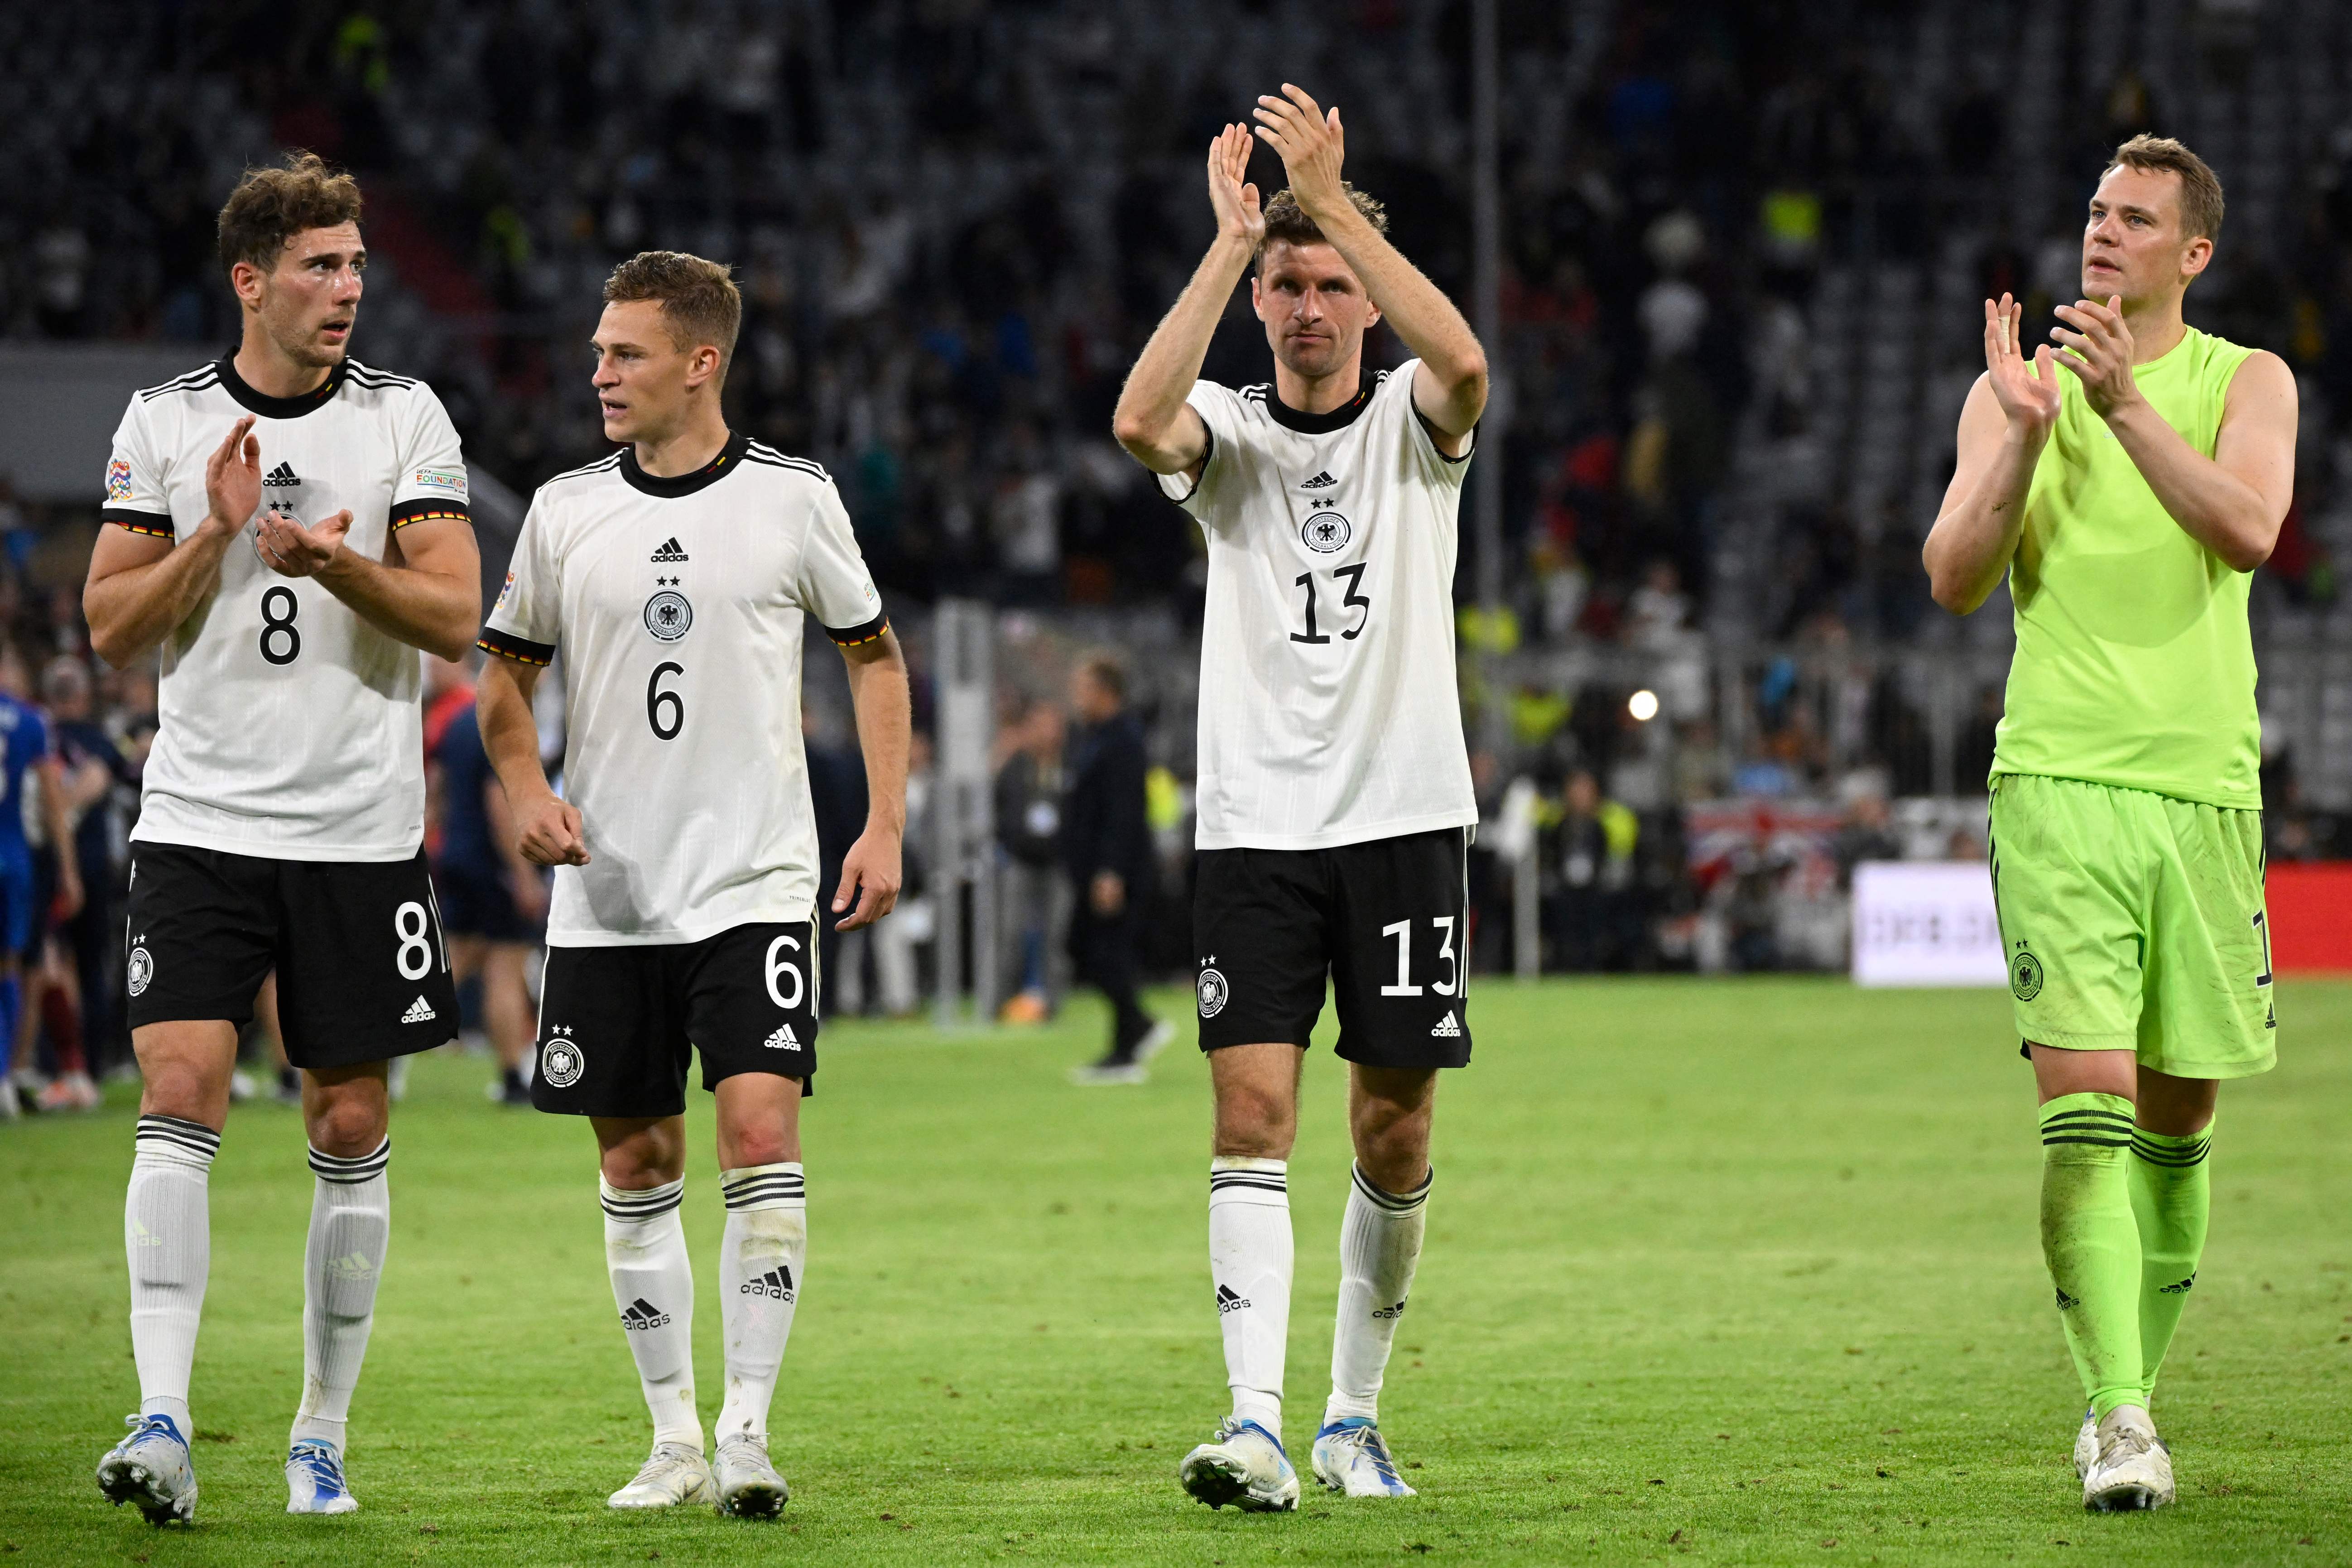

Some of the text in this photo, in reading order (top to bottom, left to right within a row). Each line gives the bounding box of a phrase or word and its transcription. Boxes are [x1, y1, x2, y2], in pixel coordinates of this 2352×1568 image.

[263, 477, 301, 487] adidas
[416, 475, 467, 488] FOUNDATION
[1301, 479, 1338, 488] adidas
[1312, 517, 1339, 526] DEUTSCHER
[650, 553, 689, 563] adidas
[655, 597, 683, 607] DEUTSCHER
[1289, 562, 1370, 645] 13
[259, 586, 301, 665] 8
[647, 661, 684, 741] 6
[394, 901, 433, 981] 8
[2252, 909, 2272, 987] 1
[1380, 915, 1456, 996] 13
[2016, 958, 2034, 970] DEUTSCHER
[765, 935, 804, 1010] 6
[1201, 975, 1218, 986] DEUTSCHER
[401, 1011, 436, 1024] adidas
[1431, 1027, 1461, 1037] adidas
[549, 1044, 573, 1055] DEUTSCHER
[764, 1039, 801, 1052] adidas
[741, 1284, 794, 1304] adidas
[1217, 1299, 1251, 1317] idas
[1372, 1309, 1403, 1318] adid
[621, 1314, 670, 1330] didas
